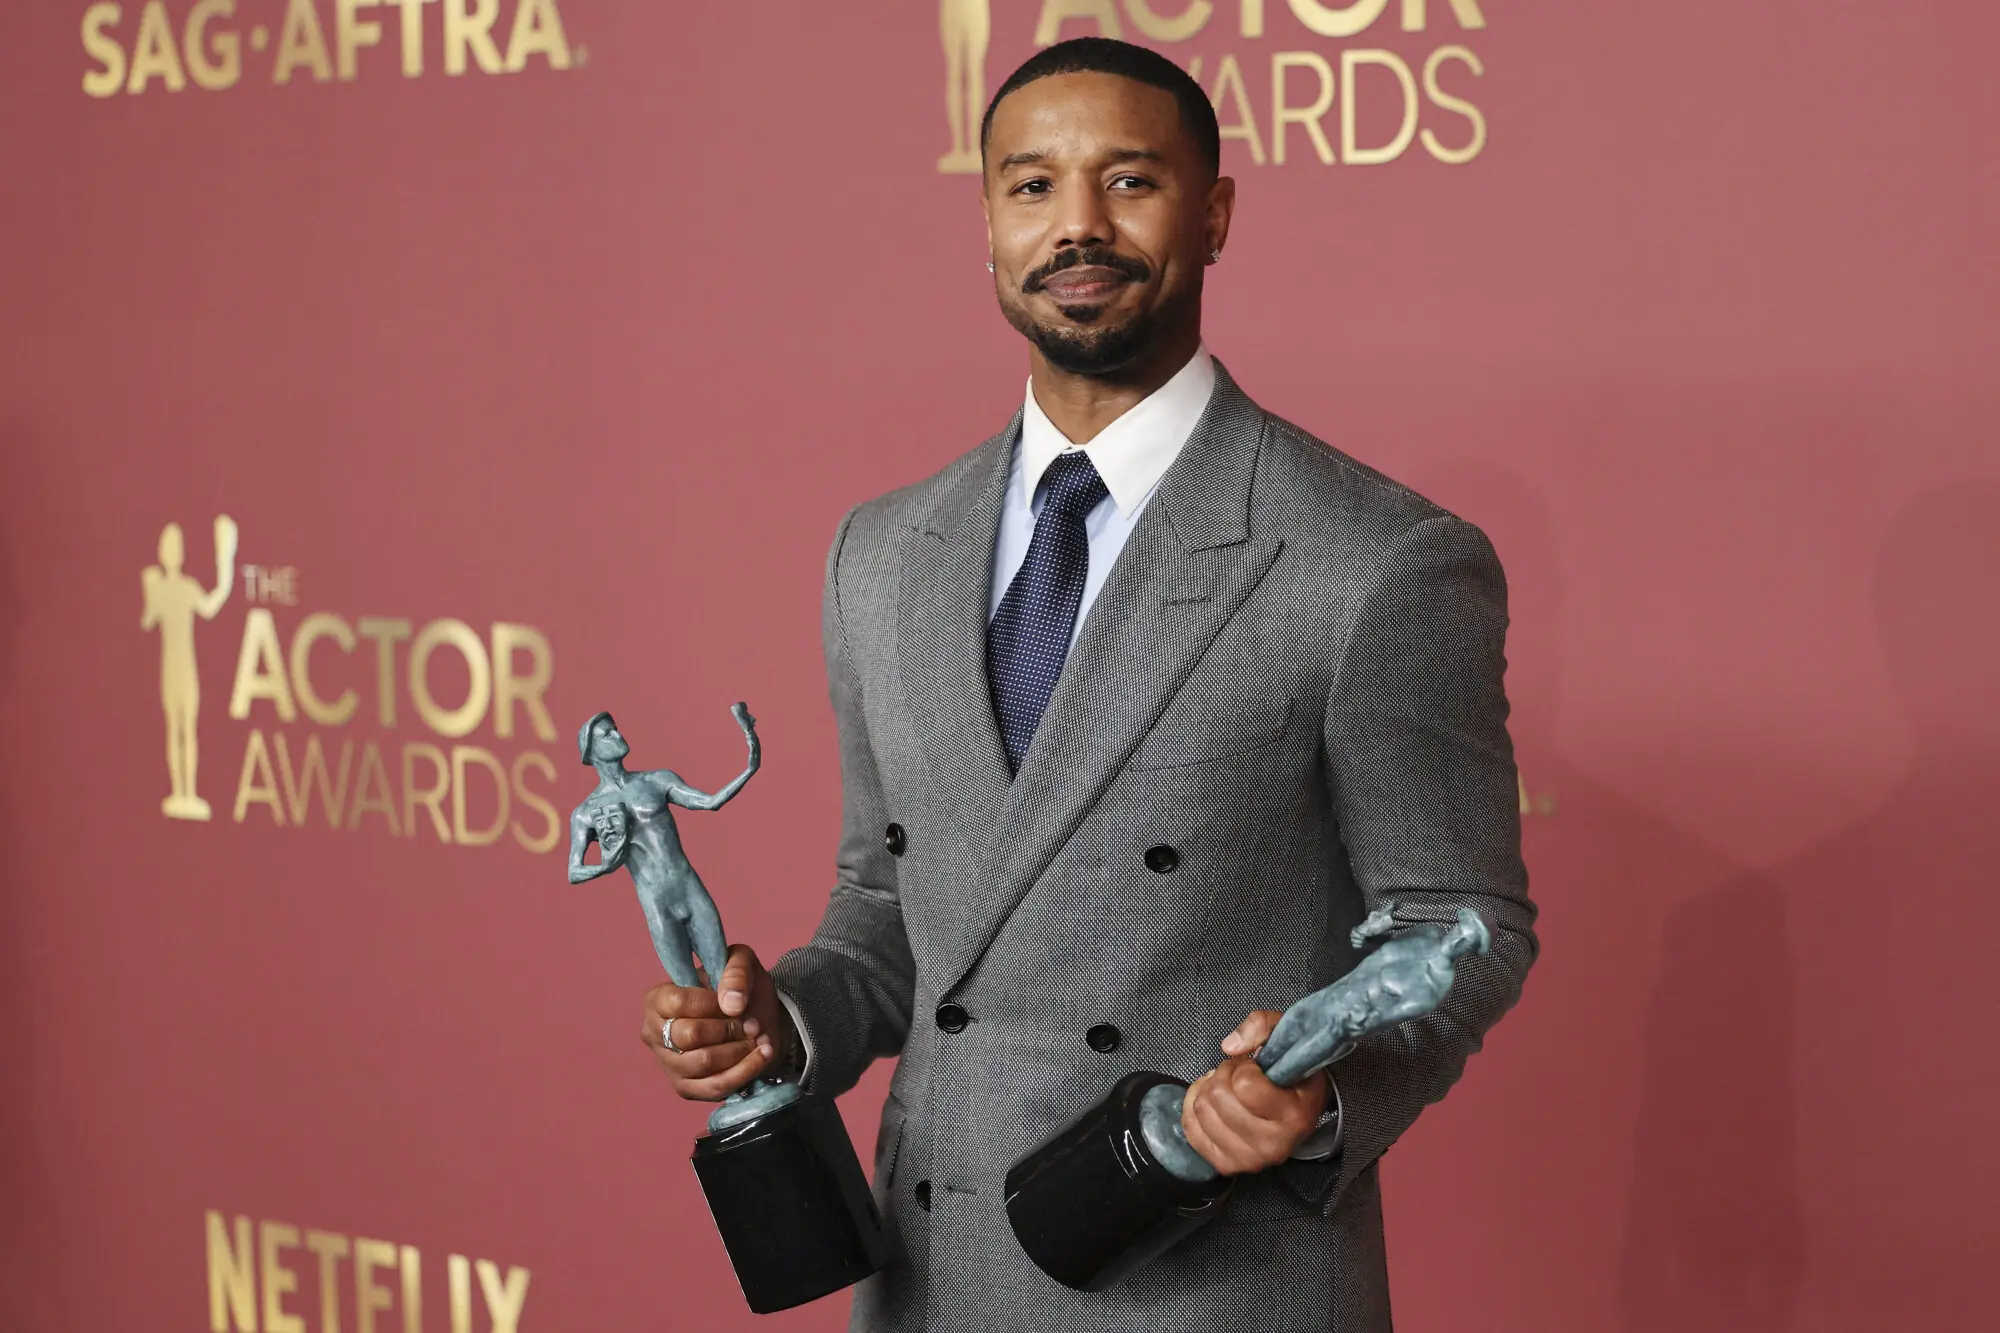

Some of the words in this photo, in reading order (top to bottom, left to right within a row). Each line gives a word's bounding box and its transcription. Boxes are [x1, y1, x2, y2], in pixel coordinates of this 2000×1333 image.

[1187, 45, 1487, 165] ARDS
[243, 564, 299, 606] THE
[229, 607, 558, 742] ACTOR
[232, 728, 561, 854] AWARDS
